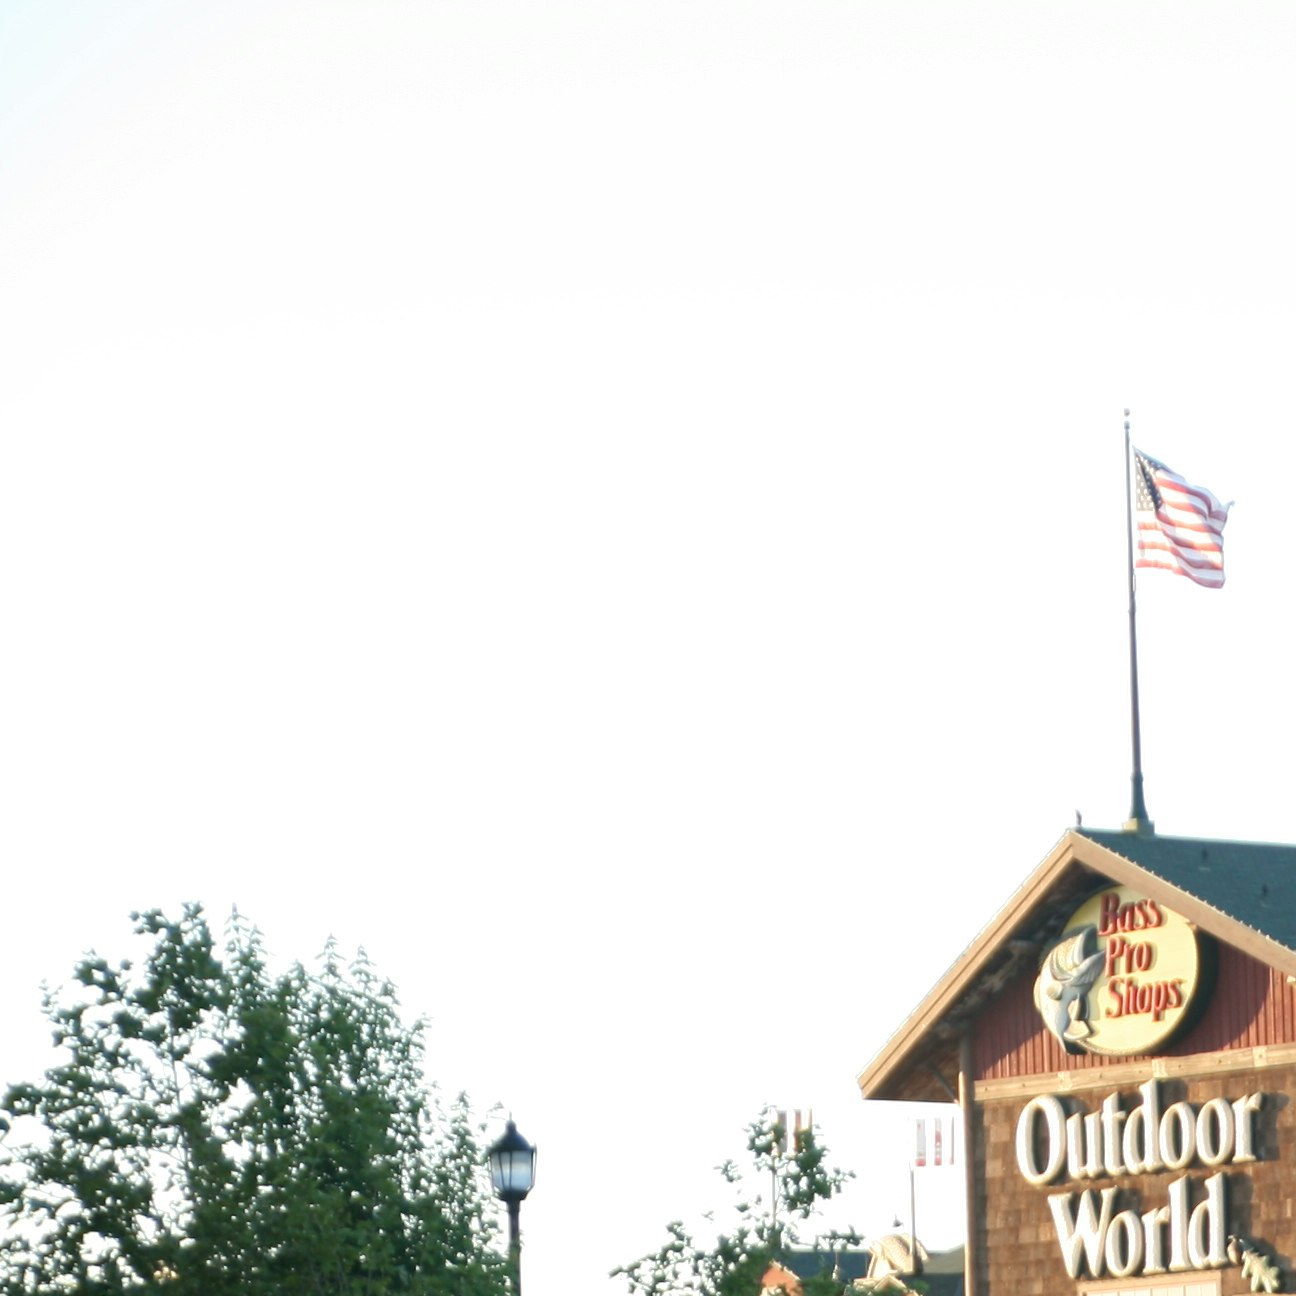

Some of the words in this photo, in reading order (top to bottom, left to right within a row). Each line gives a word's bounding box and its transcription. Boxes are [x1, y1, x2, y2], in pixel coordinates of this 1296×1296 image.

[1098, 892, 1163, 936] Bass
[1105, 936, 1153, 977] Pro
[1105, 977, 1184, 1022] Shops
[1015, 1077, 1263, 1186] Outdoor
[1047, 1171, 1229, 1280] World
